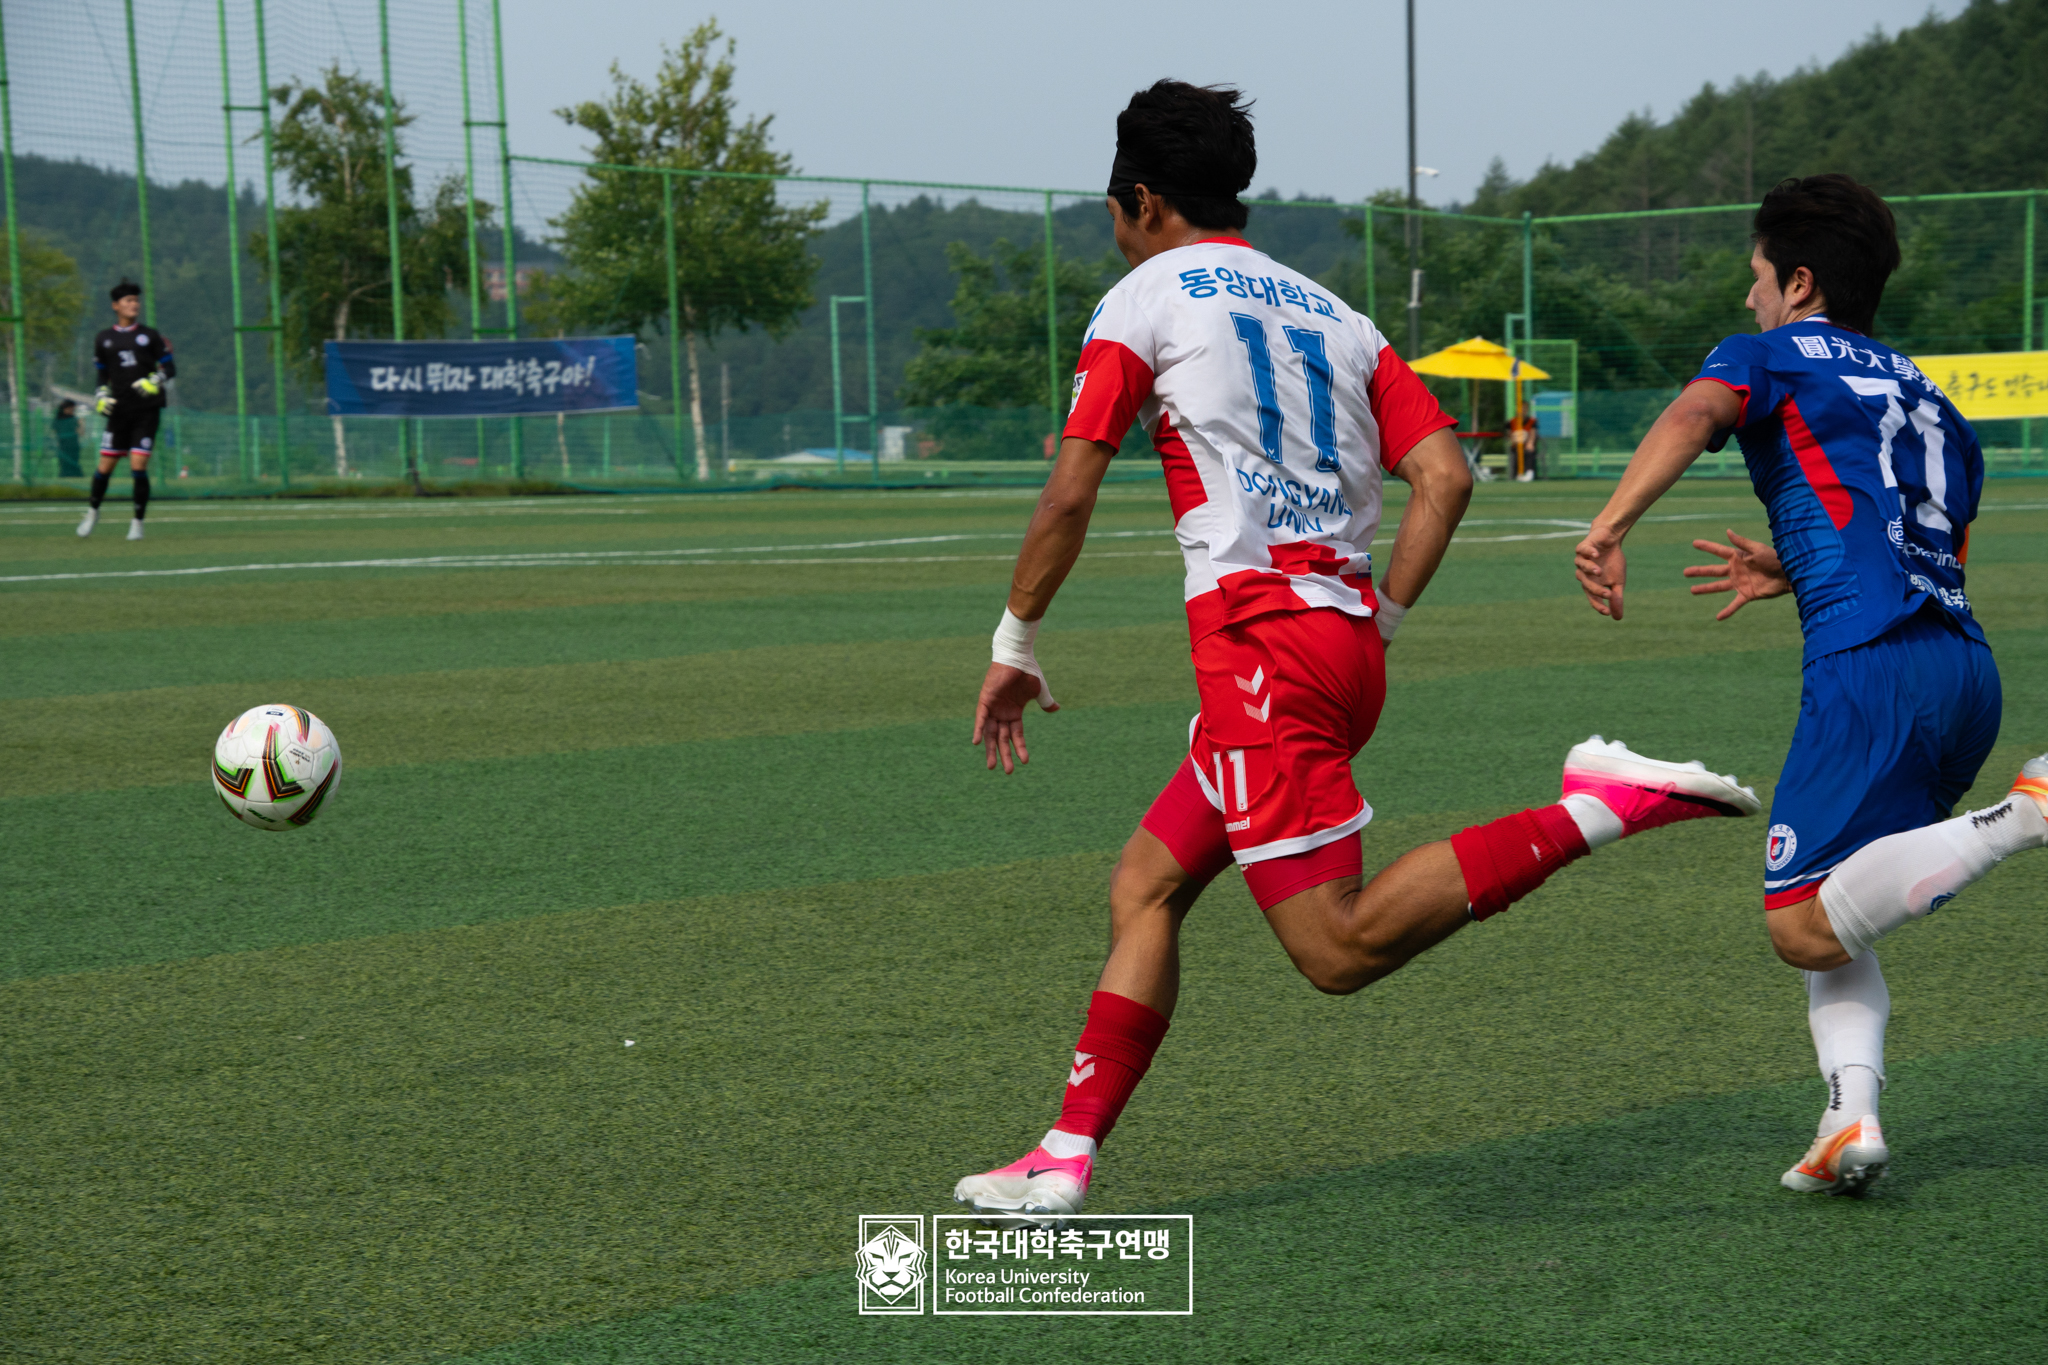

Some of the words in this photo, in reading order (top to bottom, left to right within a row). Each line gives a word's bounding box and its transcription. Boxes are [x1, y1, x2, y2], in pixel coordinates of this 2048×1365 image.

[1178, 266, 1343, 324] 동양대학교
[369, 365, 423, 393] 다시
[425, 362, 475, 394] 뛰자
[478, 355, 597, 397] 대학축구야!
[1229, 311, 1342, 473] 11
[1838, 375, 1953, 535] 71
[1212, 748, 1249, 815] 11
